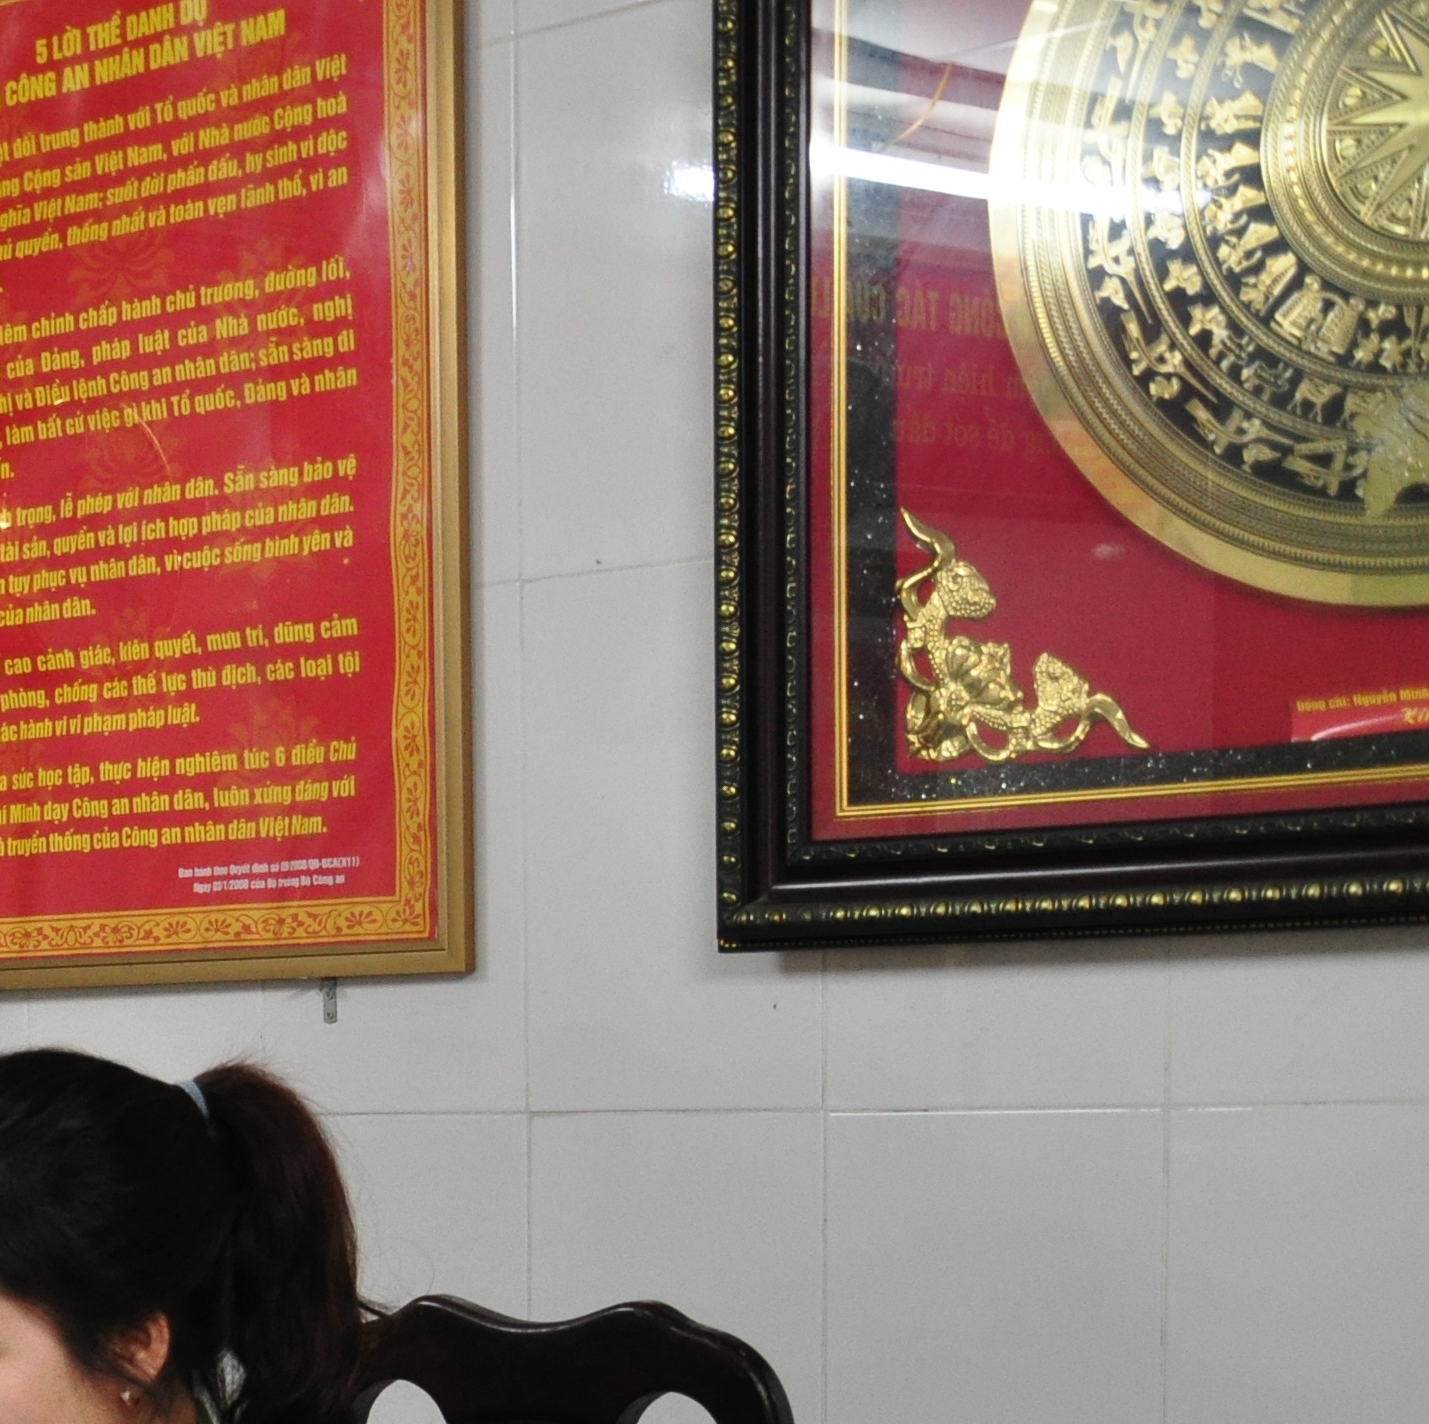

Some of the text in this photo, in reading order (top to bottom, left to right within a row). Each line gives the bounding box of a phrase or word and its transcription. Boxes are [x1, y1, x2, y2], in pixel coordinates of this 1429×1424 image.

[5, 71, 56, 105] CÔNG
[62, 63, 89, 92] AN
[94, 47, 144, 84] NHÂN
[149, 35, 188, 69] DÂN
[193, 21, 235, 58] VIỆT
[239, 8, 285, 45] NAM
[36, 38, 47, 63] 5
[52, 25, 81, 59] LỜI
[86, 10, 120, 50] THỀ
[126, 2, 174, 40] DANH
[12, 132, 36, 158] đối
[39, 128, 79, 152] trung
[83, 114, 123, 141] thành
[127, 106, 150, 129] với
[154, 95, 173, 123] Tổ
[177, 88, 215, 119] quốc
[220, 84, 238, 107] và
[242, 74, 278, 101] nhân
[282, 65, 310, 89] dân
[315, 53, 346, 80] Việt
[31, 312, 74, 338] chỉnh
[79, 300, 117, 329] chấp
[121, 295, 160, 320] hành
[166, 285, 195, 312] chủ
[200, 278, 259, 305] trương,
[264, 265, 316, 292] đường
[322, 254, 349, 281] lối,
[4, 657, 31, 674] cao
[37, 648, 74, 670] cảnh
[79, 644, 114, 668] giác,
[119, 639, 148, 661] kiên
[154, 630, 201, 659] quyết,
[206, 630, 240, 650] mưu
[245, 625, 268, 646] trí,
[274, 621, 314, 643] dũng
[320, 613, 357, 638] cảm
[0, 688, 49, 711] phòng,
[55, 679, 97, 703] chống
[102, 678, 127, 698] các
[132, 670, 156, 695] thế
[161, 672, 185, 695] lực
[191, 667, 216, 688] thù
[222, 663, 260, 688] địch,
[266, 659, 294, 680] các
[300, 654, 332, 679] loại
[338, 651, 359, 676] tội
[12, 767, 33, 789] sức
[38, 767, 62, 789] học
[67, 763, 93, 787] tập,
[99, 761, 131, 783] thực
[137, 756, 169, 780] hiện
[175, 751, 237, 775] nghiêm
[243, 748, 269, 769] túc
[275, 746, 285, 766] 6
[291, 738, 324, 764] điều
[329, 736, 356, 761] Chủ
[6, 830, 46, 856] truyền
[48, 829, 90, 852] thống
[93, 827, 119, 848] của
[122, 826, 157, 847] Công
[161, 827, 181, 844] an
[184, 821, 225, 842] nhân
[228, 818, 255, 839] dân
[259, 816, 289, 840] Việt
[291, 814, 326, 834] Nam.
